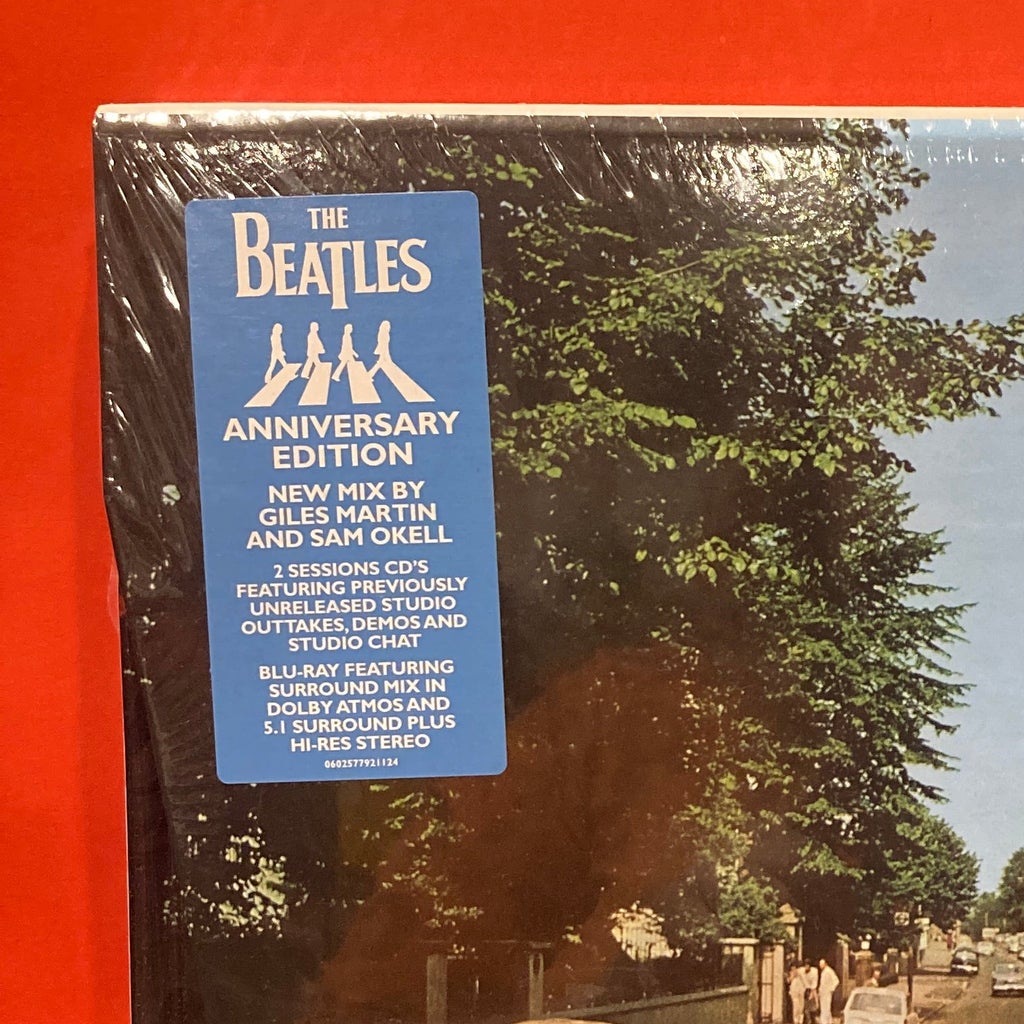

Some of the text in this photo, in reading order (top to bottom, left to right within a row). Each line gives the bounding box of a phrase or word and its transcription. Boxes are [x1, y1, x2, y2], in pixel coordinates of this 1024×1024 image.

[306, 206, 349, 230] THE
[231, 211, 432, 310] BEATLES
[222, 410, 460, 442] ANNIVERSARY
[272, 441, 413, 469] EDITION
[268, 480, 425, 504] NEW MIX BY
[258, 502, 437, 526] GILES MARTIN
[246, 524, 453, 550] AND SAM OKELL
[273, 559, 429, 579] 2 SESSIONS CD'S
[236, 576, 468, 598] FEATURING PREVIOUSLY
[250, 595, 457, 617] UNRELEASED STUDIO
[240, 613, 468, 635] OUTTAKES, DEMOS AND
[288, 633, 422, 652] STUDIO CHAT
[258, 659, 455, 680] BLU-RAY FEATURING
[268, 678, 446, 698] SURROUND MIX IN
[266, 696, 451, 717] DOLBY ATMOS AND
[263, 714, 456, 735] 5.1 SURROUND PLUS
[290, 733, 431, 753] HI-RES STEREO
[324, 757, 399, 769] 0602577921124
